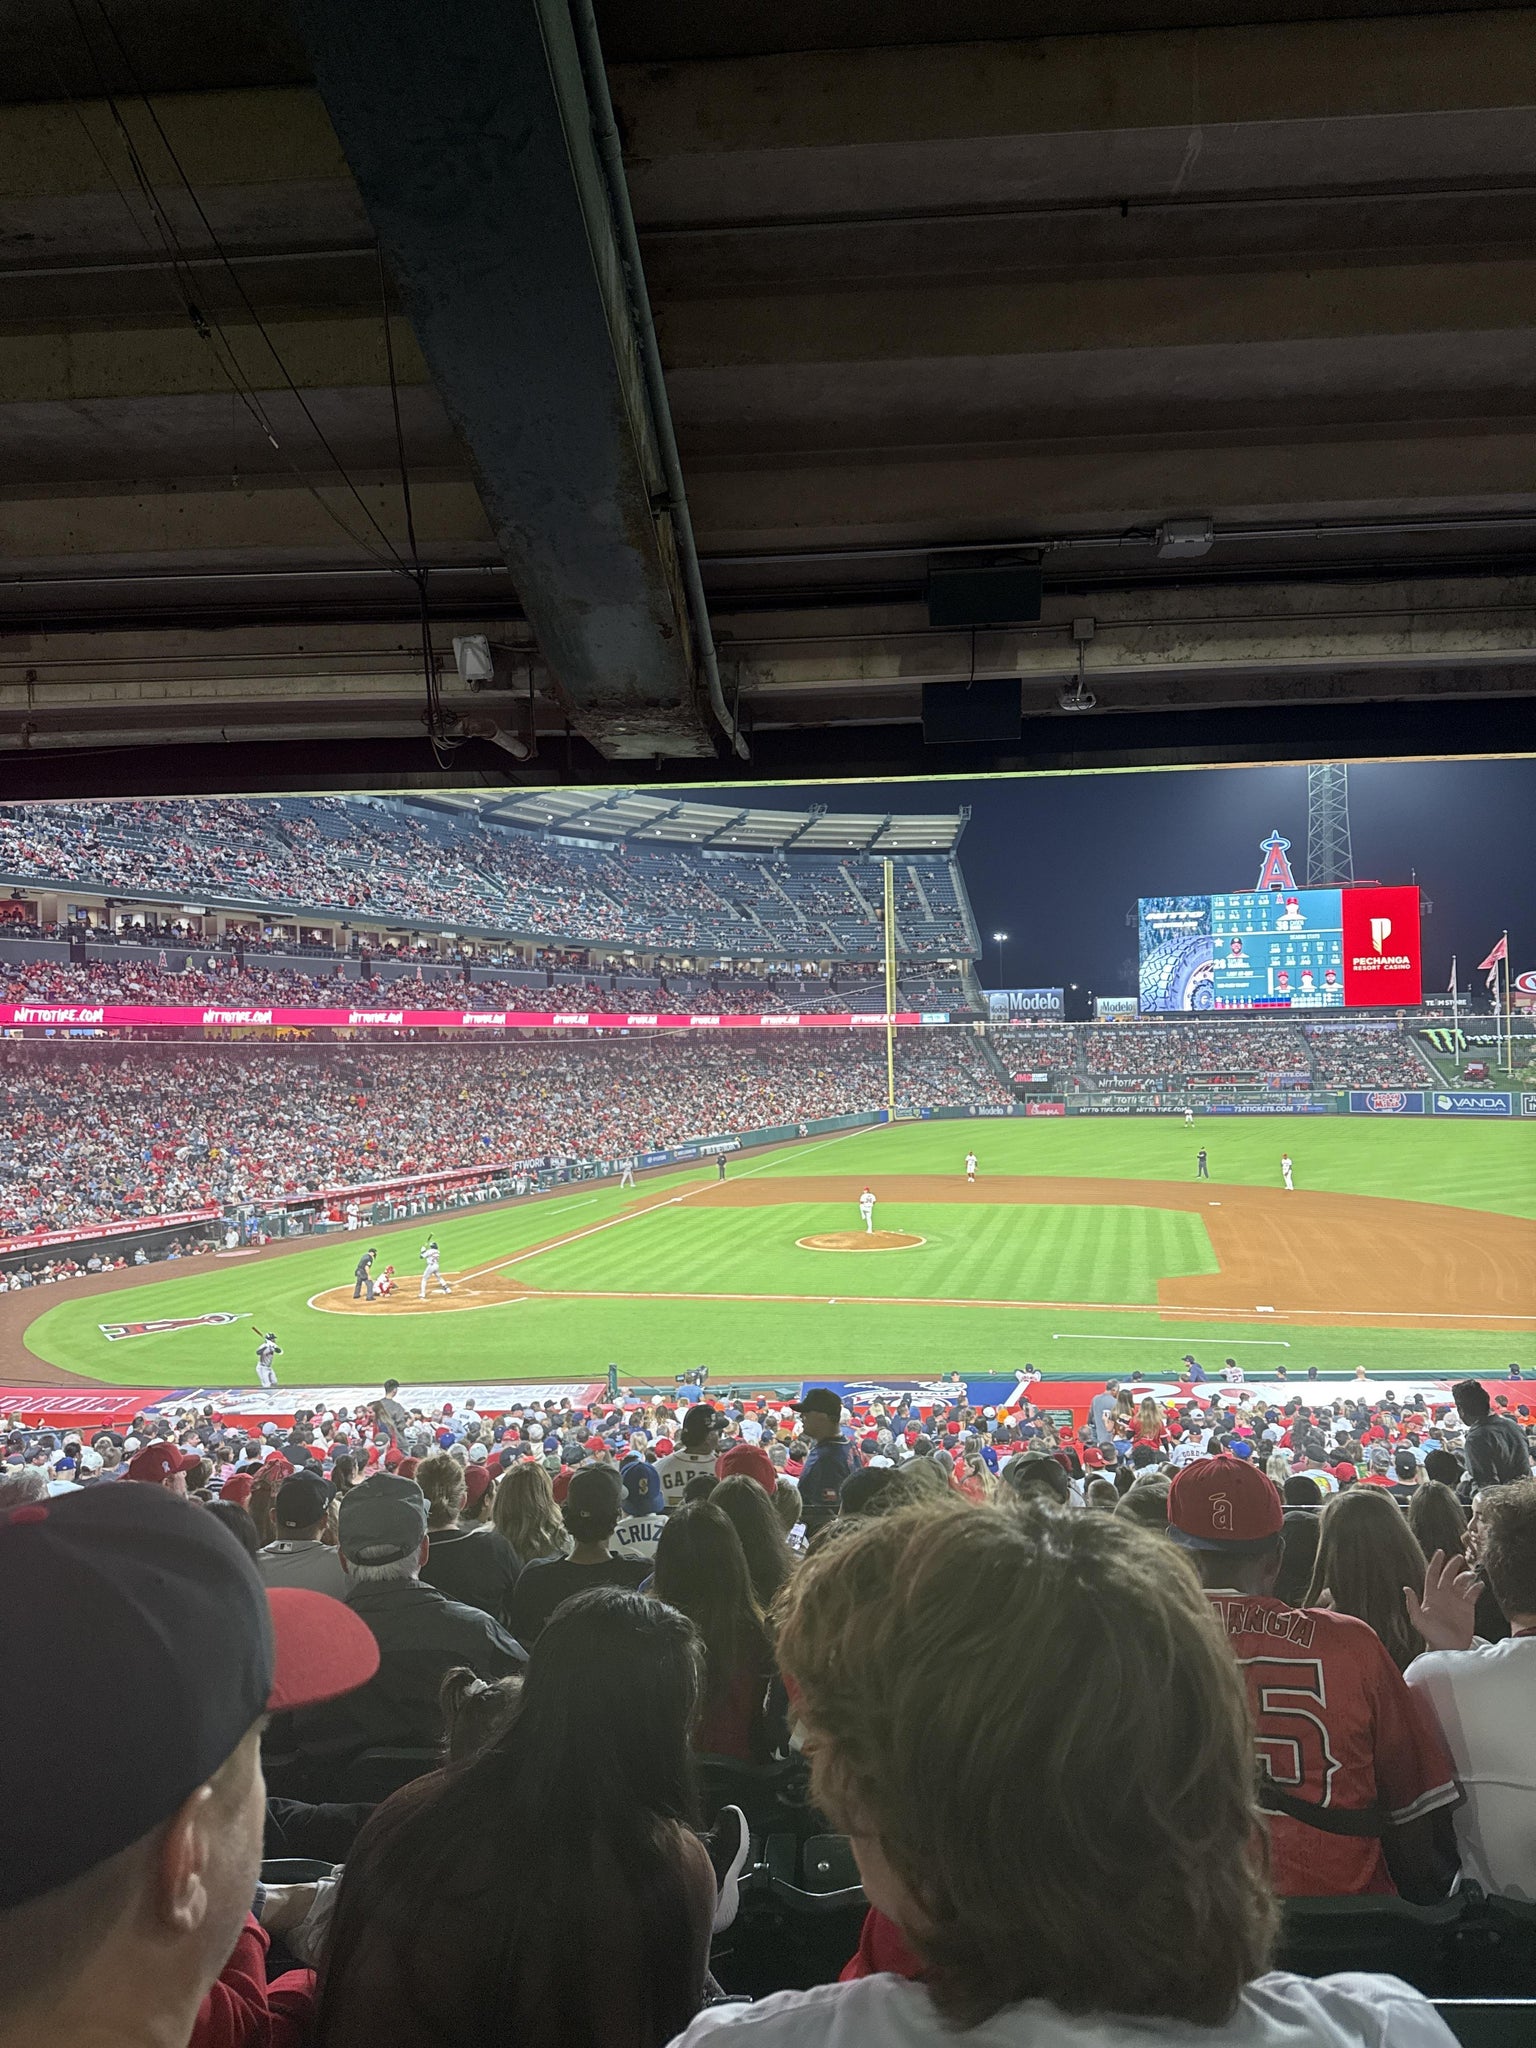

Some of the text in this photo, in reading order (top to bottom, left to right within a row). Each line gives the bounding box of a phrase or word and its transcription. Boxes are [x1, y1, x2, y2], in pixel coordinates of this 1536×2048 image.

[1255, 830, 1298, 892] A
[1353, 956, 1410, 966] PECHANGA
[1010, 992, 1060, 1011] Modelo
[1102, 1001, 1134, 1012] Modelo
[14, 1006, 104, 1022] NITTOTIRE.COM
[978, 1106, 1004, 1115] Modelo
[1453, 1098, 1507, 1107] VANDA
[662, 1470, 714, 1489] GAR
[1212, 1498, 1234, 1531] a
[616, 1522, 665, 1546] CRUZ
